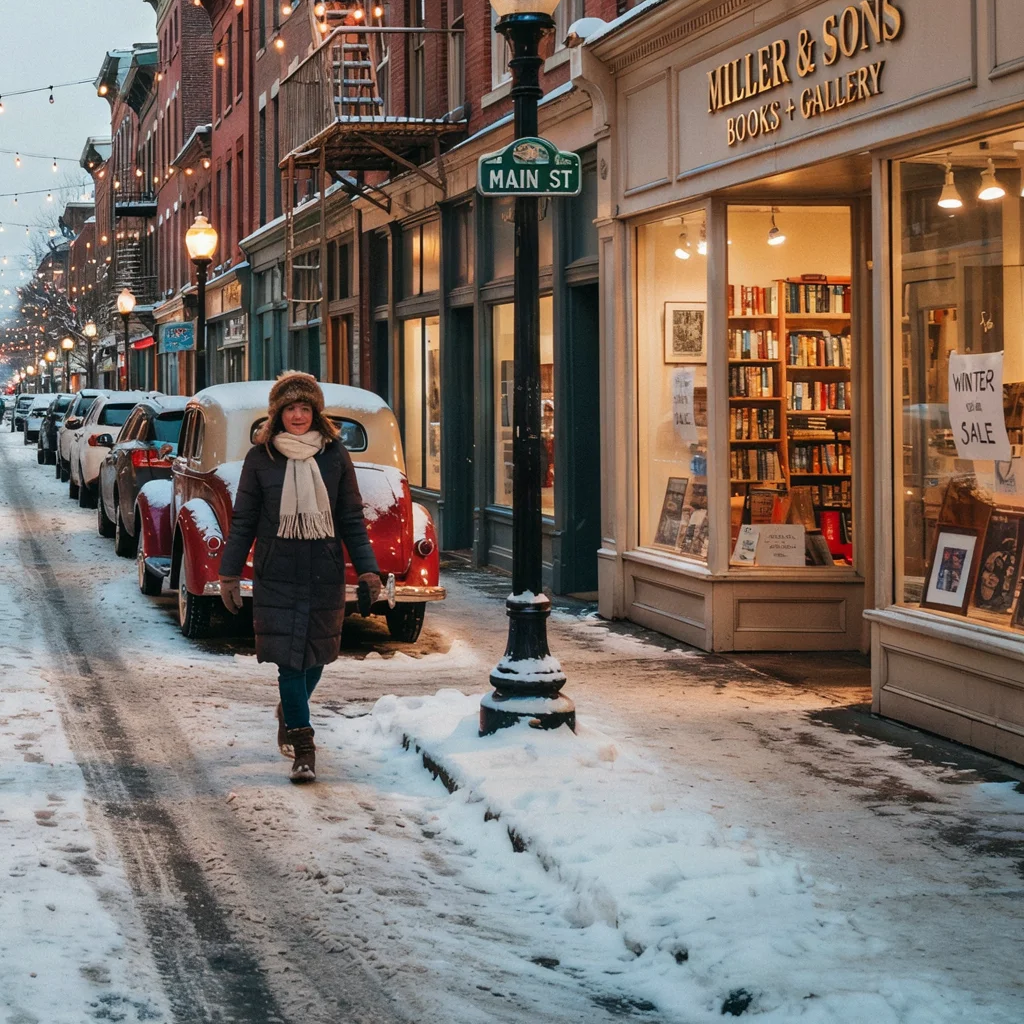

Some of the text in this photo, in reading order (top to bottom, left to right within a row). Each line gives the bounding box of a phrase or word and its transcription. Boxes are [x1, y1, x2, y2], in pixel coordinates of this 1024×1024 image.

[706, 38, 790, 114] MILLER
[796, 29, 817, 78] &
[726, 101, 781, 147] BOOKS
[800, 60, 886, 119] GALLERY
[489, 169, 573, 189] MAIN ST
[952, 369, 995, 392] WINTER
[961, 421, 996, 445] SALE
